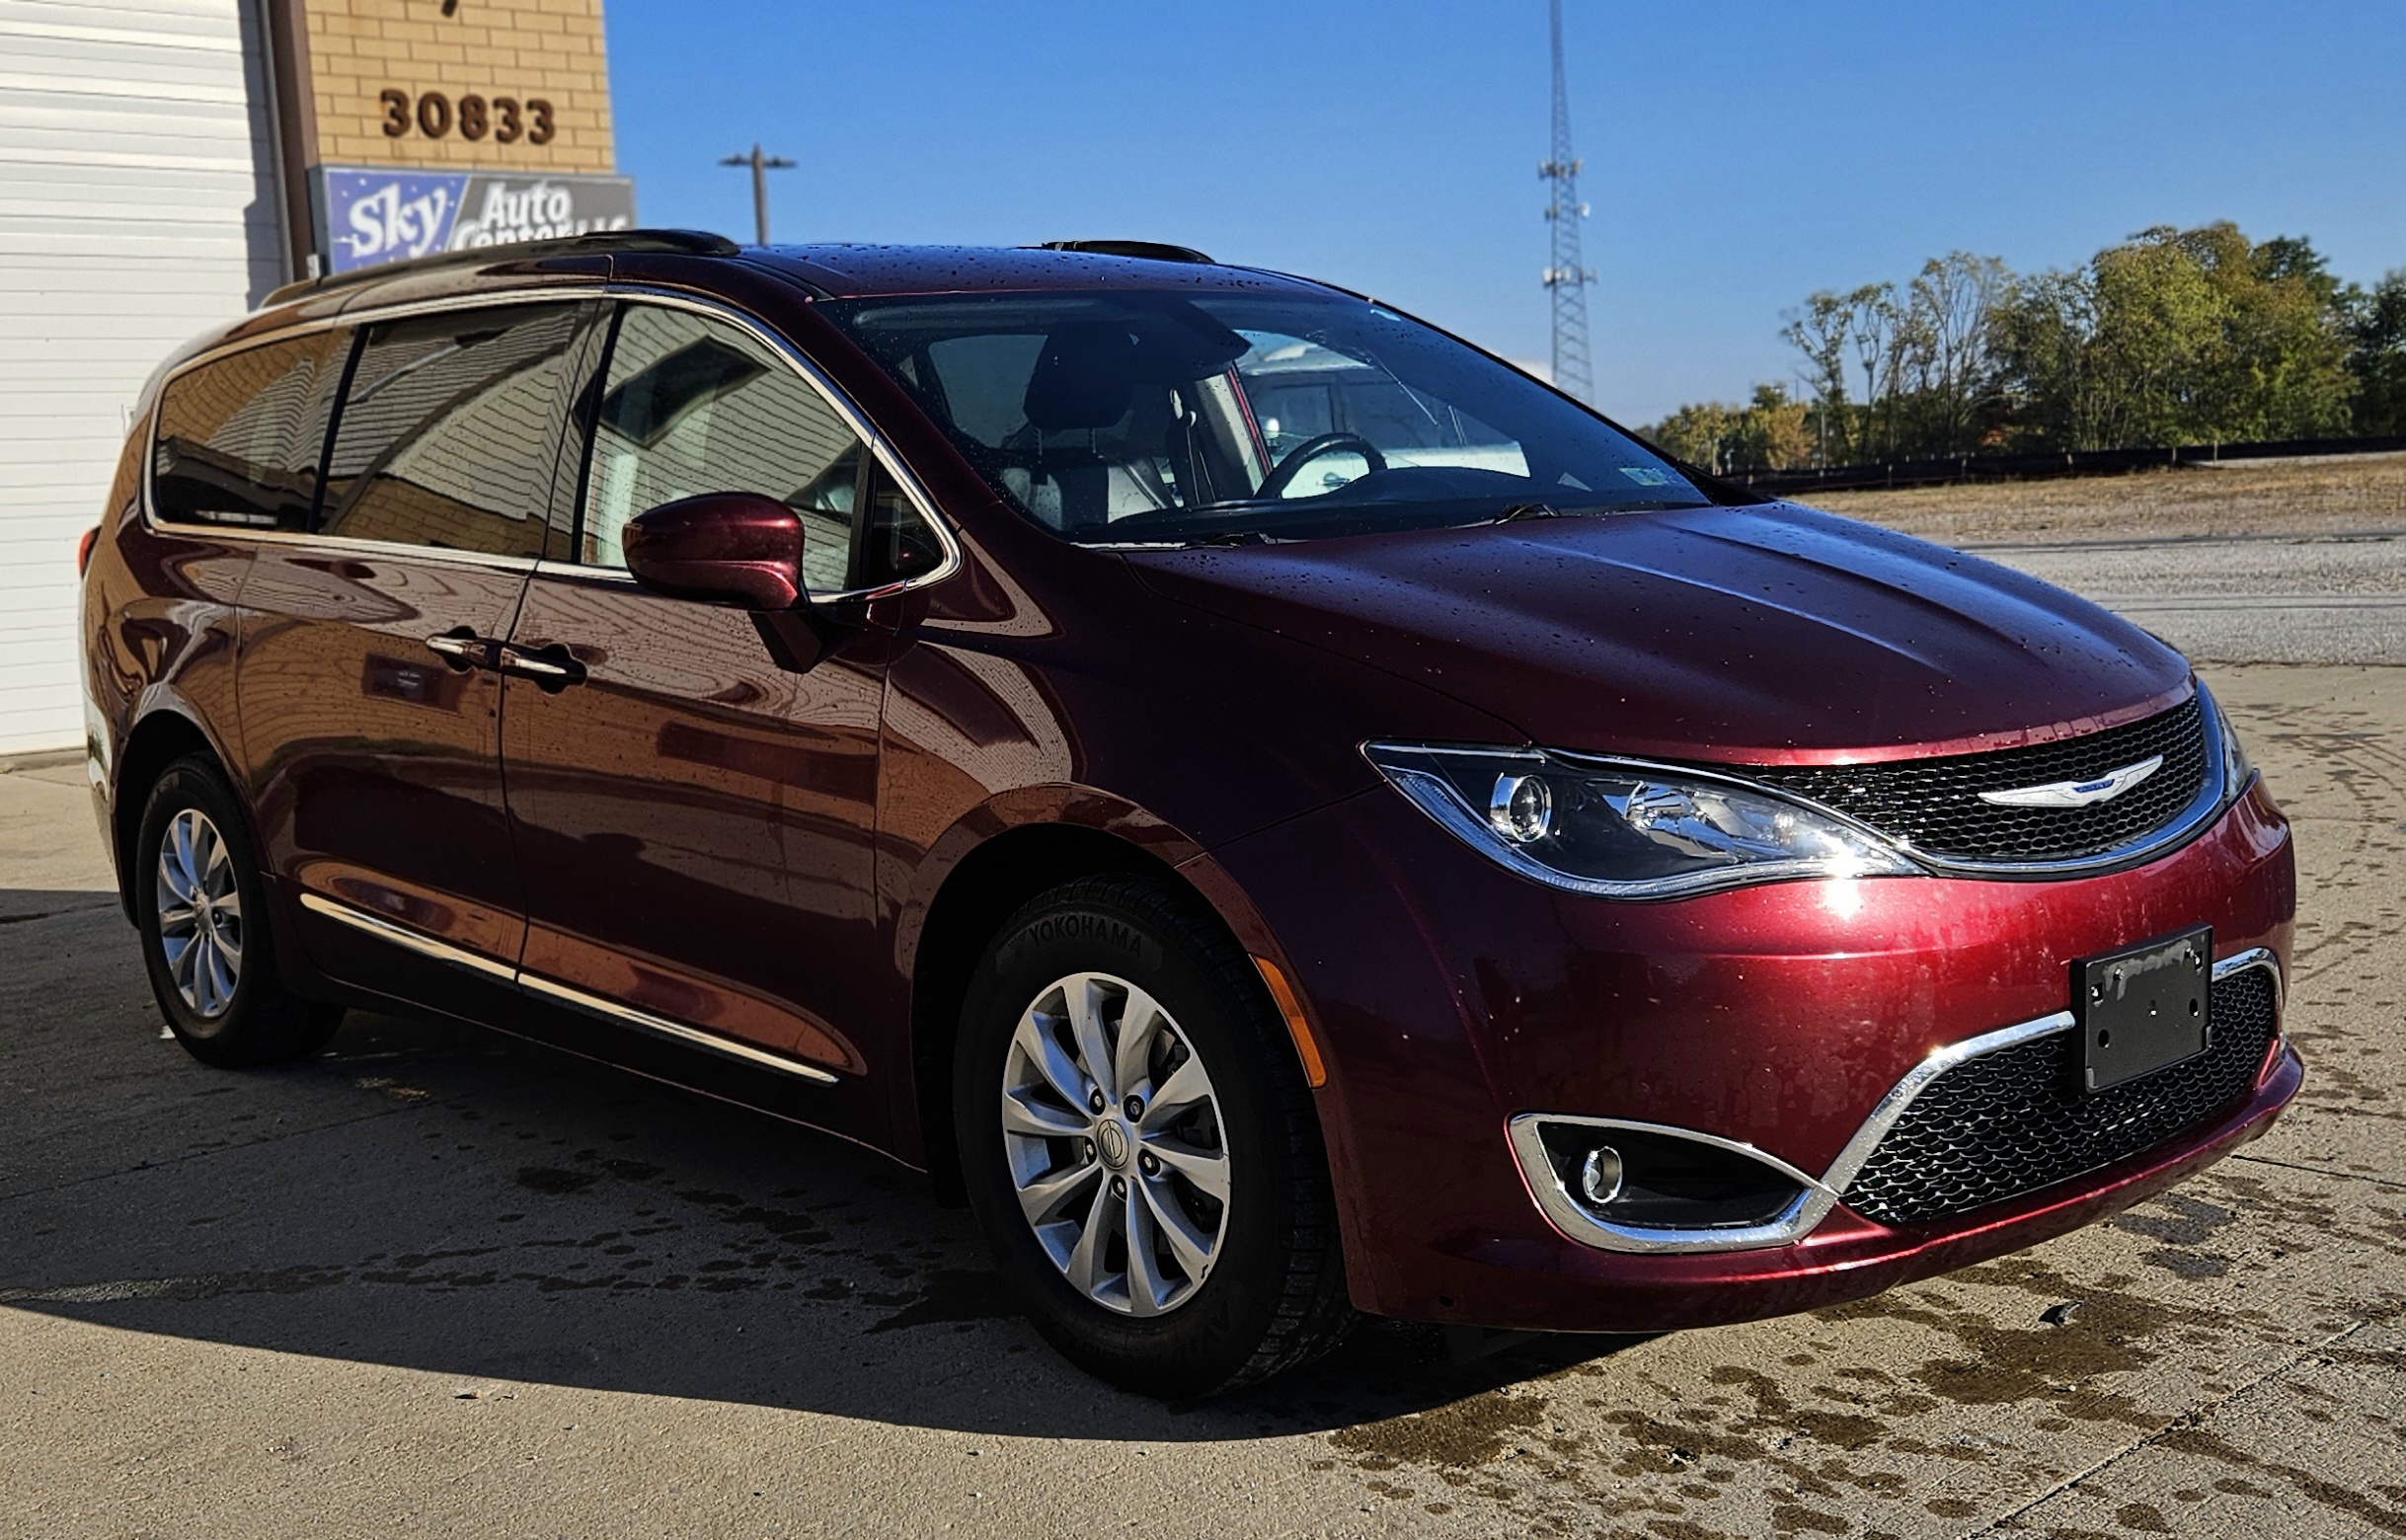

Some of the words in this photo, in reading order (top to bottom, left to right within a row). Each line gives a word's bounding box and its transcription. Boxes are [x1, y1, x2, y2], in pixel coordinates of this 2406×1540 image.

[380, 89, 556, 145] 30833
[349, 184, 448, 259] Sky
[480, 182, 573, 231] Auto
[1028, 914, 1142, 959] YOKOHAMA
